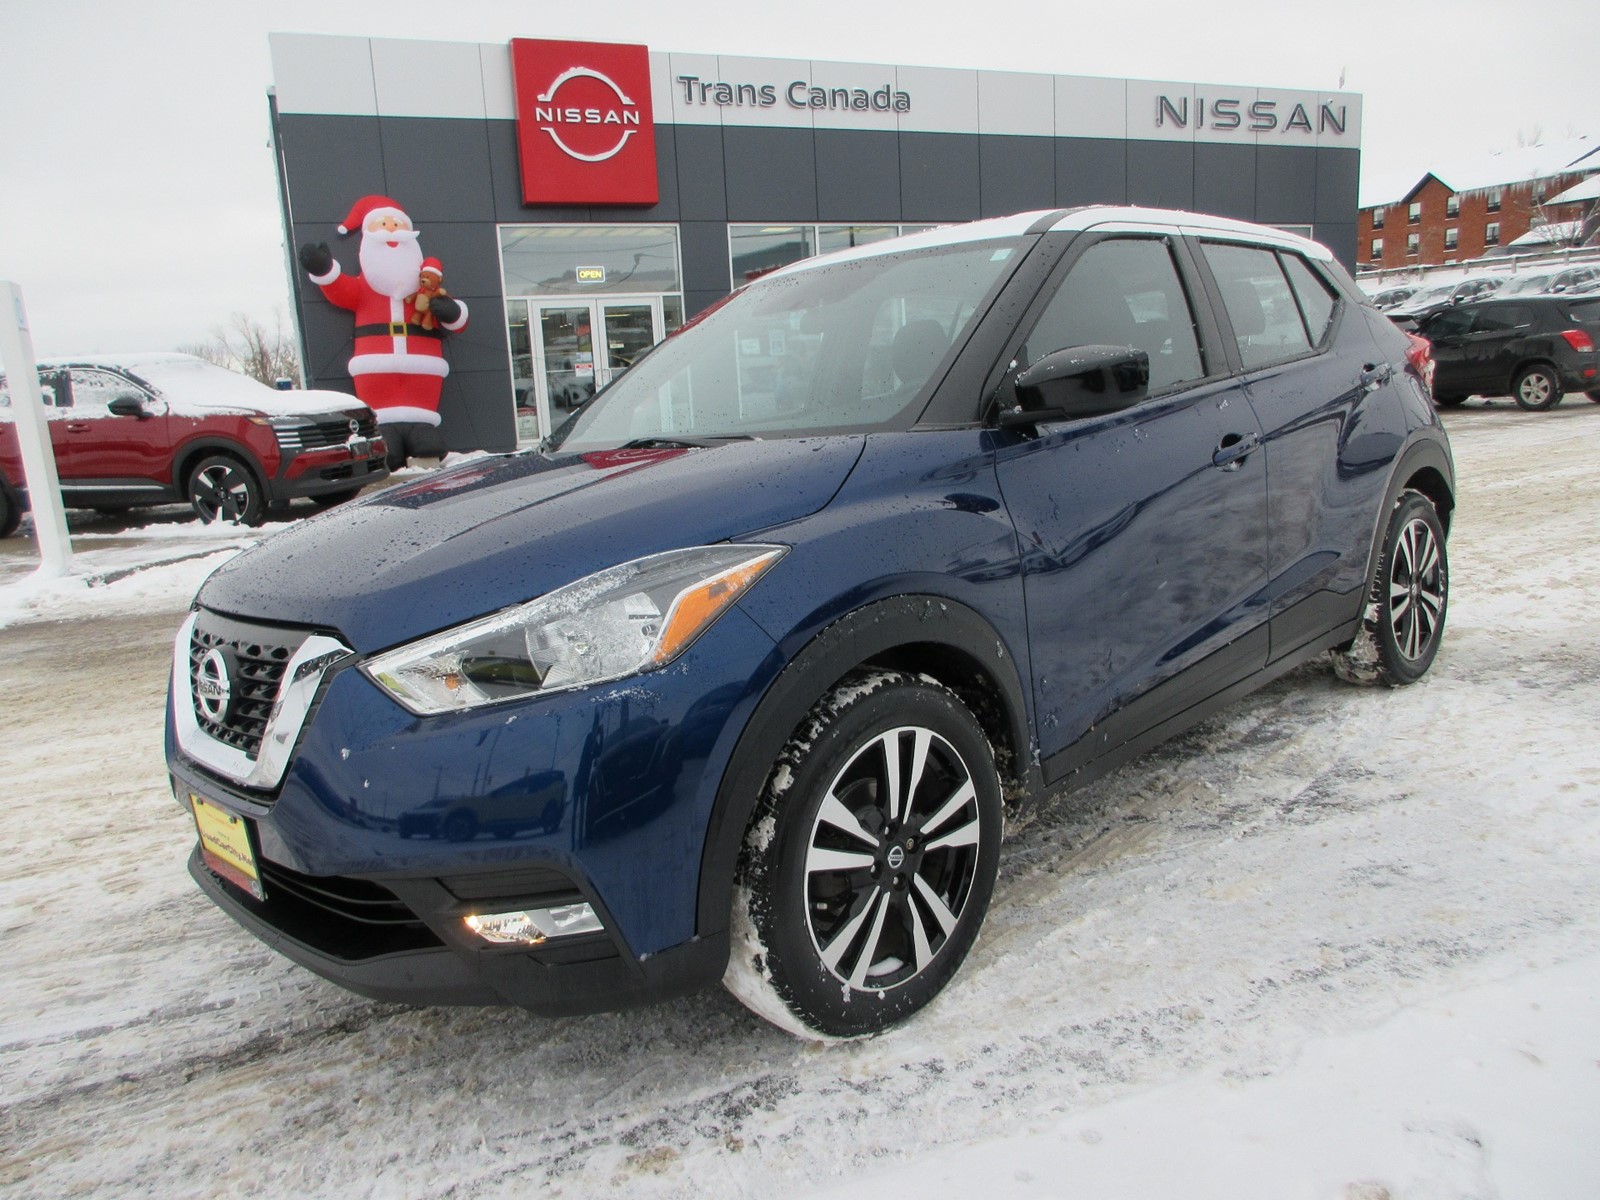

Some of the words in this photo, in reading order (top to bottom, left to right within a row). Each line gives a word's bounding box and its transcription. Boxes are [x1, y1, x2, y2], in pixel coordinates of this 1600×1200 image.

[678, 75, 777, 106] Trans
[786, 80, 911, 112] Canada
[535, 107, 639, 125] NISSAN
[1156, 95, 1346, 135] NISSAN
[579, 270, 602, 278] OPEN
